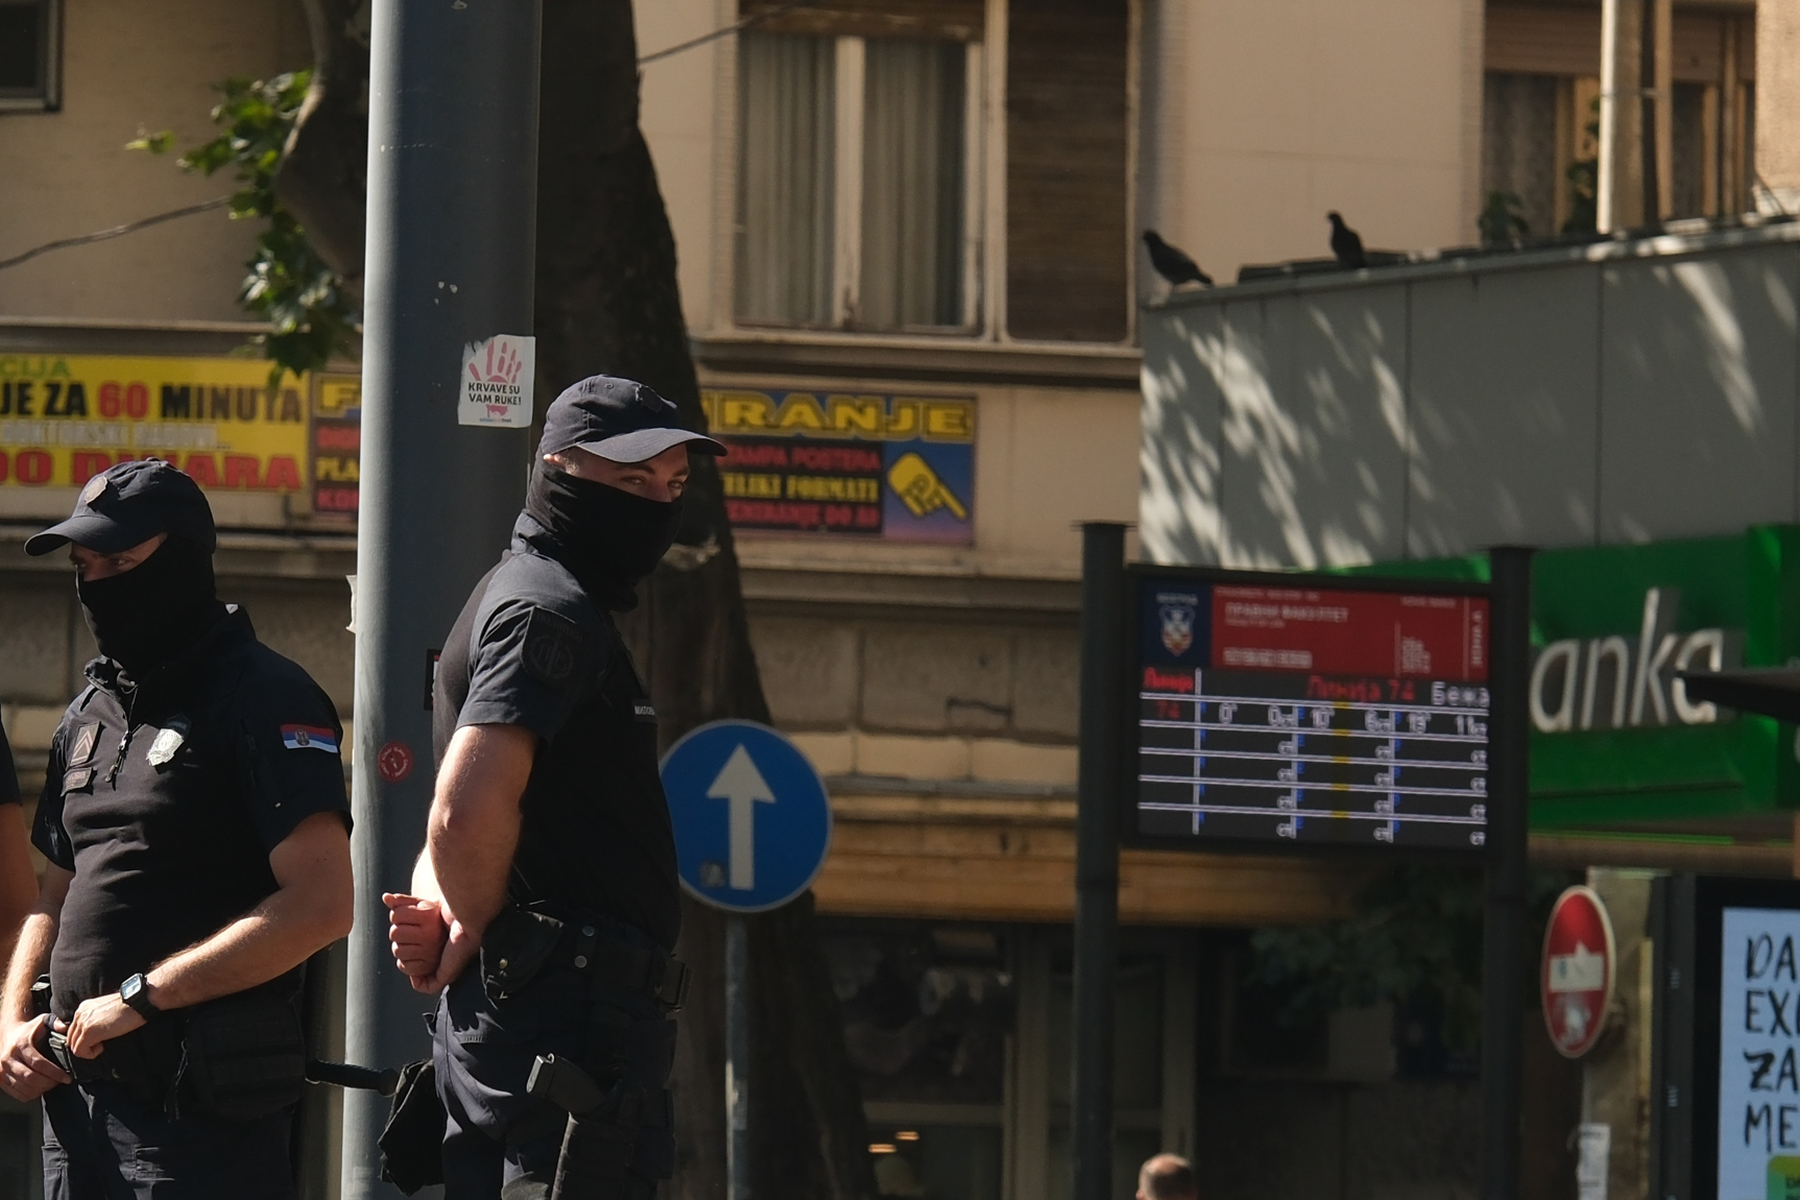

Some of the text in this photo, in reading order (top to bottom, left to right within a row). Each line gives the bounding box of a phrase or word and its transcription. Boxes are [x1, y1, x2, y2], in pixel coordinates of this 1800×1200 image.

[44, 382, 87, 416] ZA
[99, 381, 149, 419] 60
[161, 383, 302, 423] MINUTA
[468, 382, 520, 394] KRVAVE SU
[468, 393, 522, 405] VAM RUKE!
[72, 451, 302, 490] DARA
[1529, 586, 1724, 733] anka
